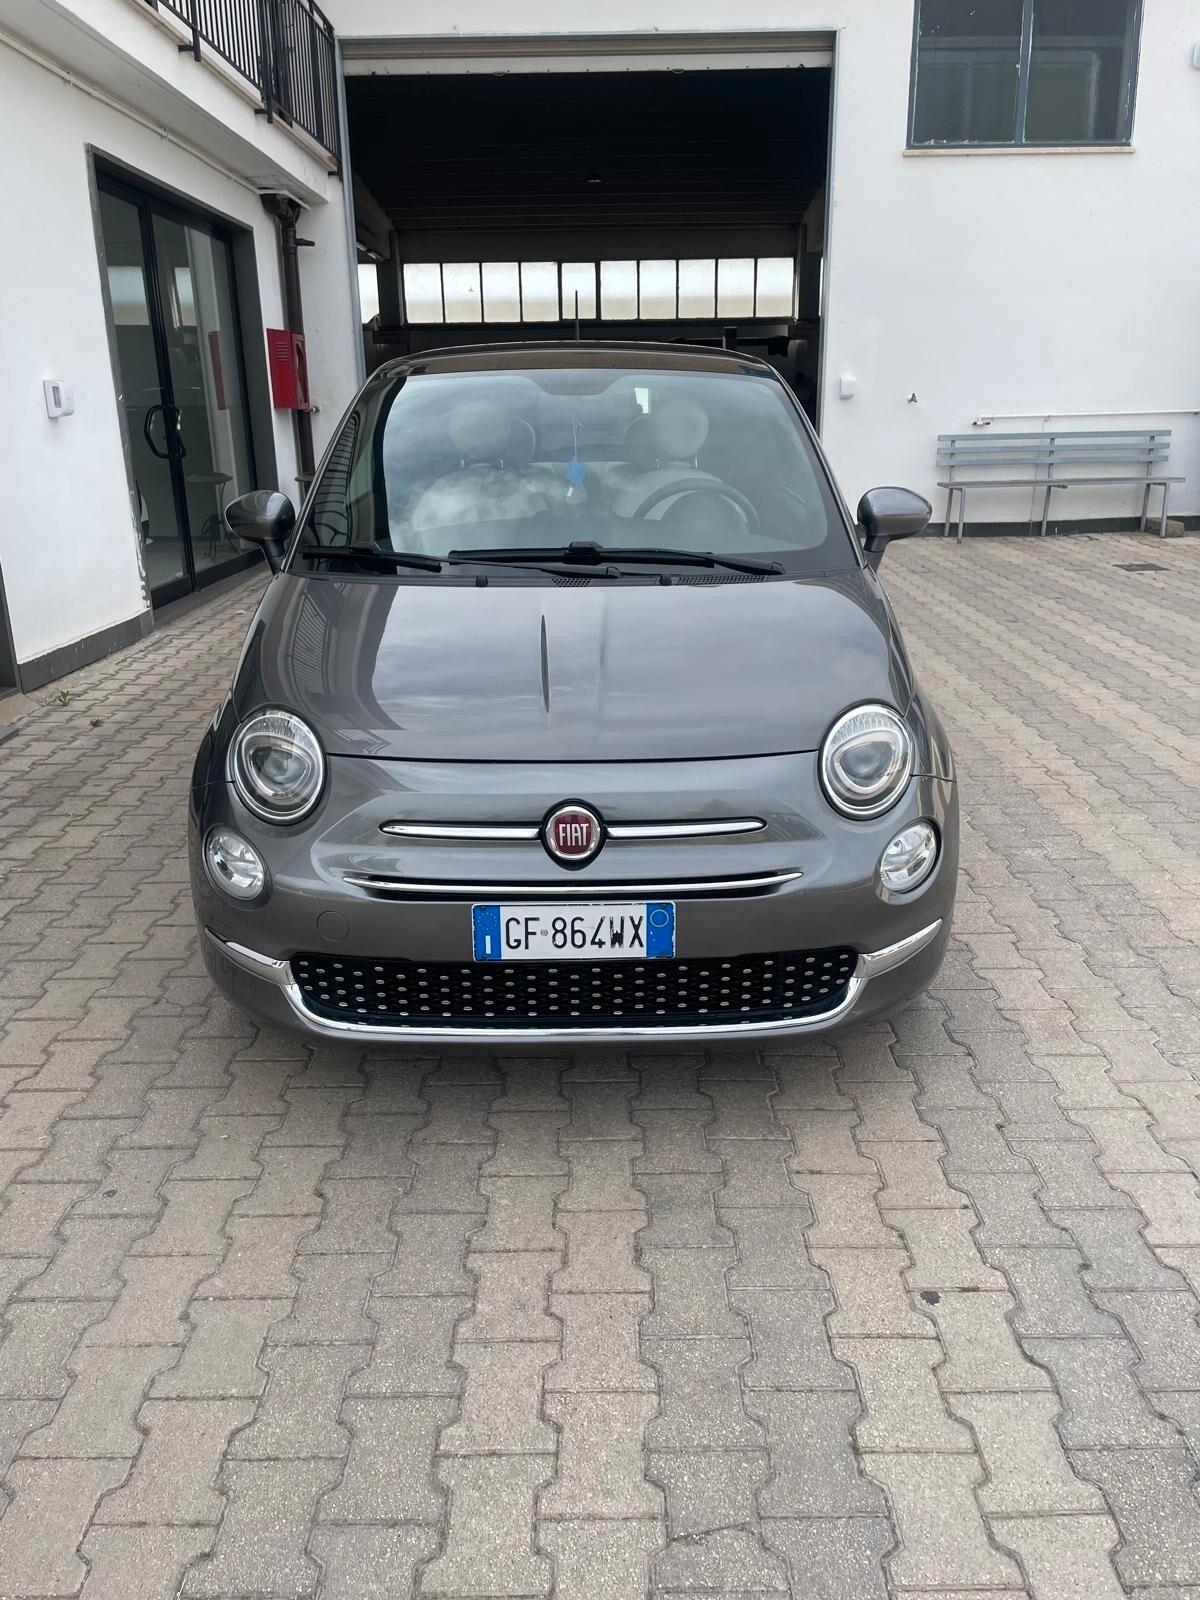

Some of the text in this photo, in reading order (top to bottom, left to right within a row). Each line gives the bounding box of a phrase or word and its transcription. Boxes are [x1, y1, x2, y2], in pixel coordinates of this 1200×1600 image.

[559, 823, 589, 847] FIAT
[505, 915, 645, 950] GF 864WX
